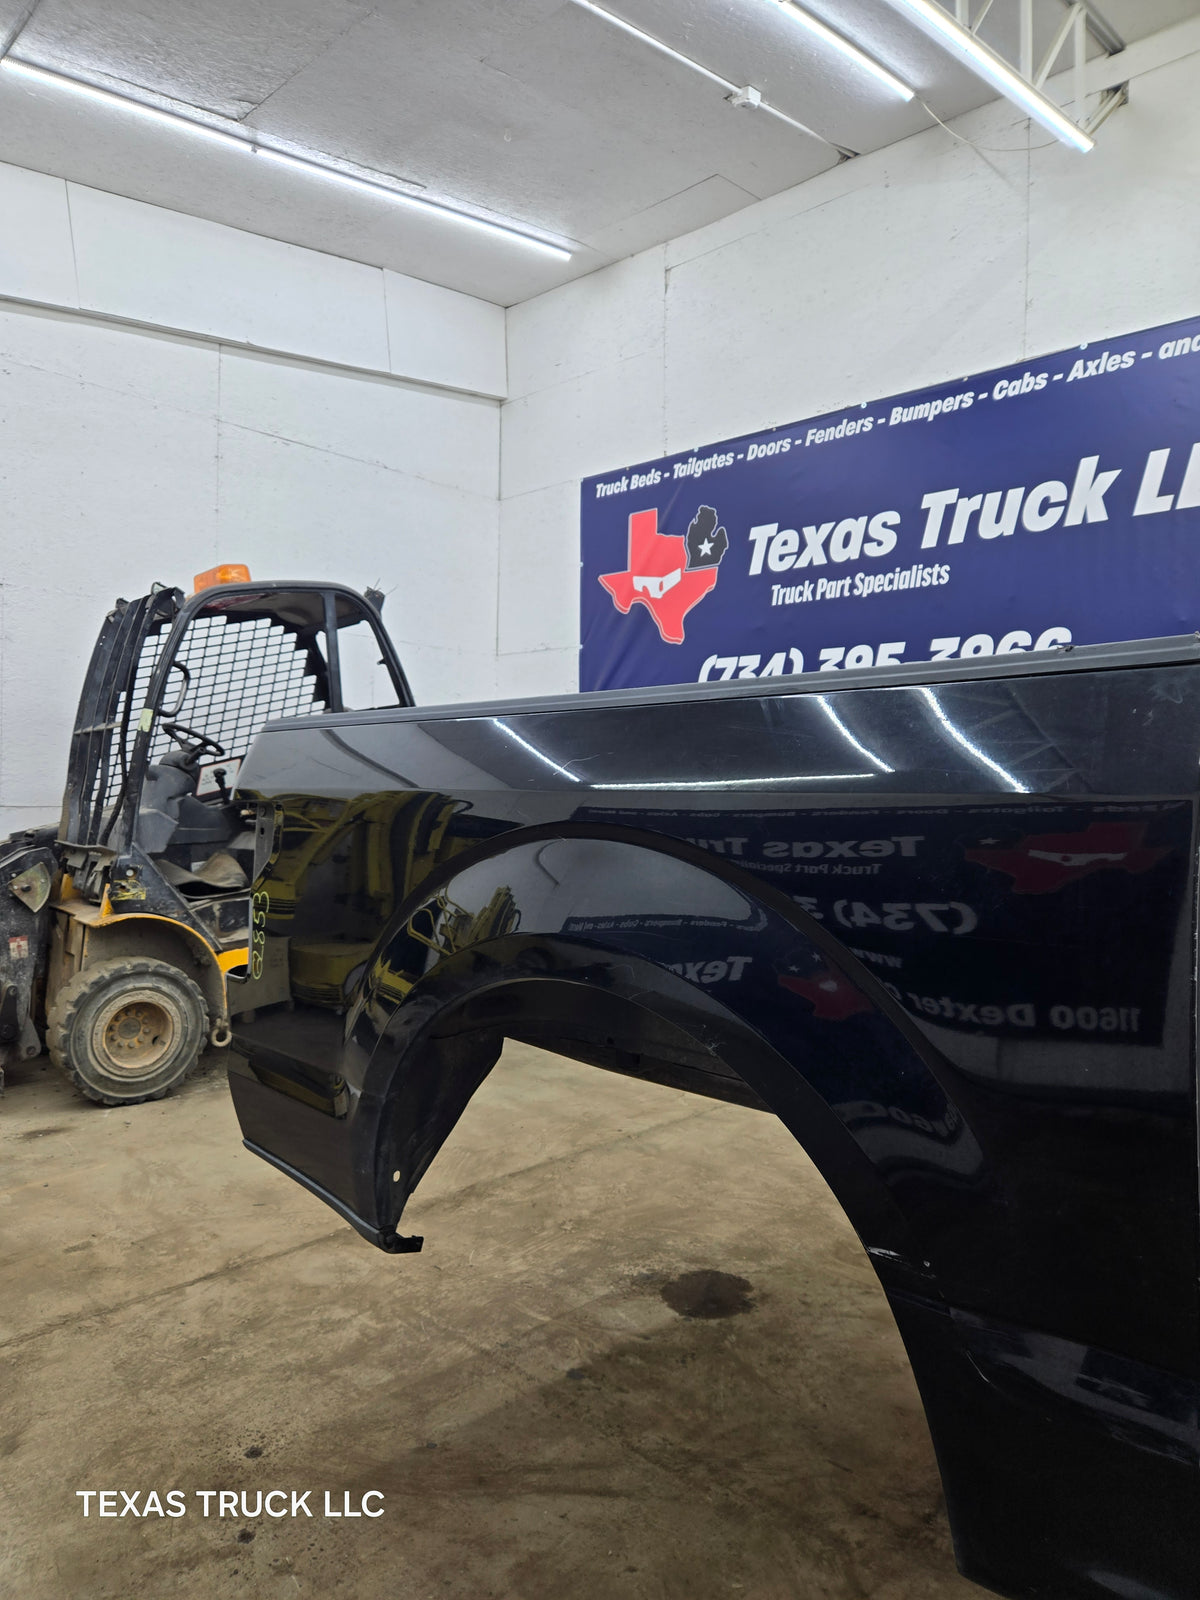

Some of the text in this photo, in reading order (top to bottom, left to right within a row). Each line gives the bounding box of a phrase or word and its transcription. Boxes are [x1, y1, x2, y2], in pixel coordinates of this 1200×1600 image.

[595, 475, 629, 499] Truck
[630, 468, 662, 490] Beds
[673, 452, 735, 480] Tailgates
[746, 437, 792, 461] Doors
[804, 416, 875, 447] Fenders
[889, 391, 975, 426] Bumpers
[992, 371, 1049, 401] Cabs
[1066, 350, 1137, 383] Axles
[748, 510, 900, 576] Texas
[920, 455, 1122, 550] Truck
[771, 563, 951, 607] Truck Part Specialists
